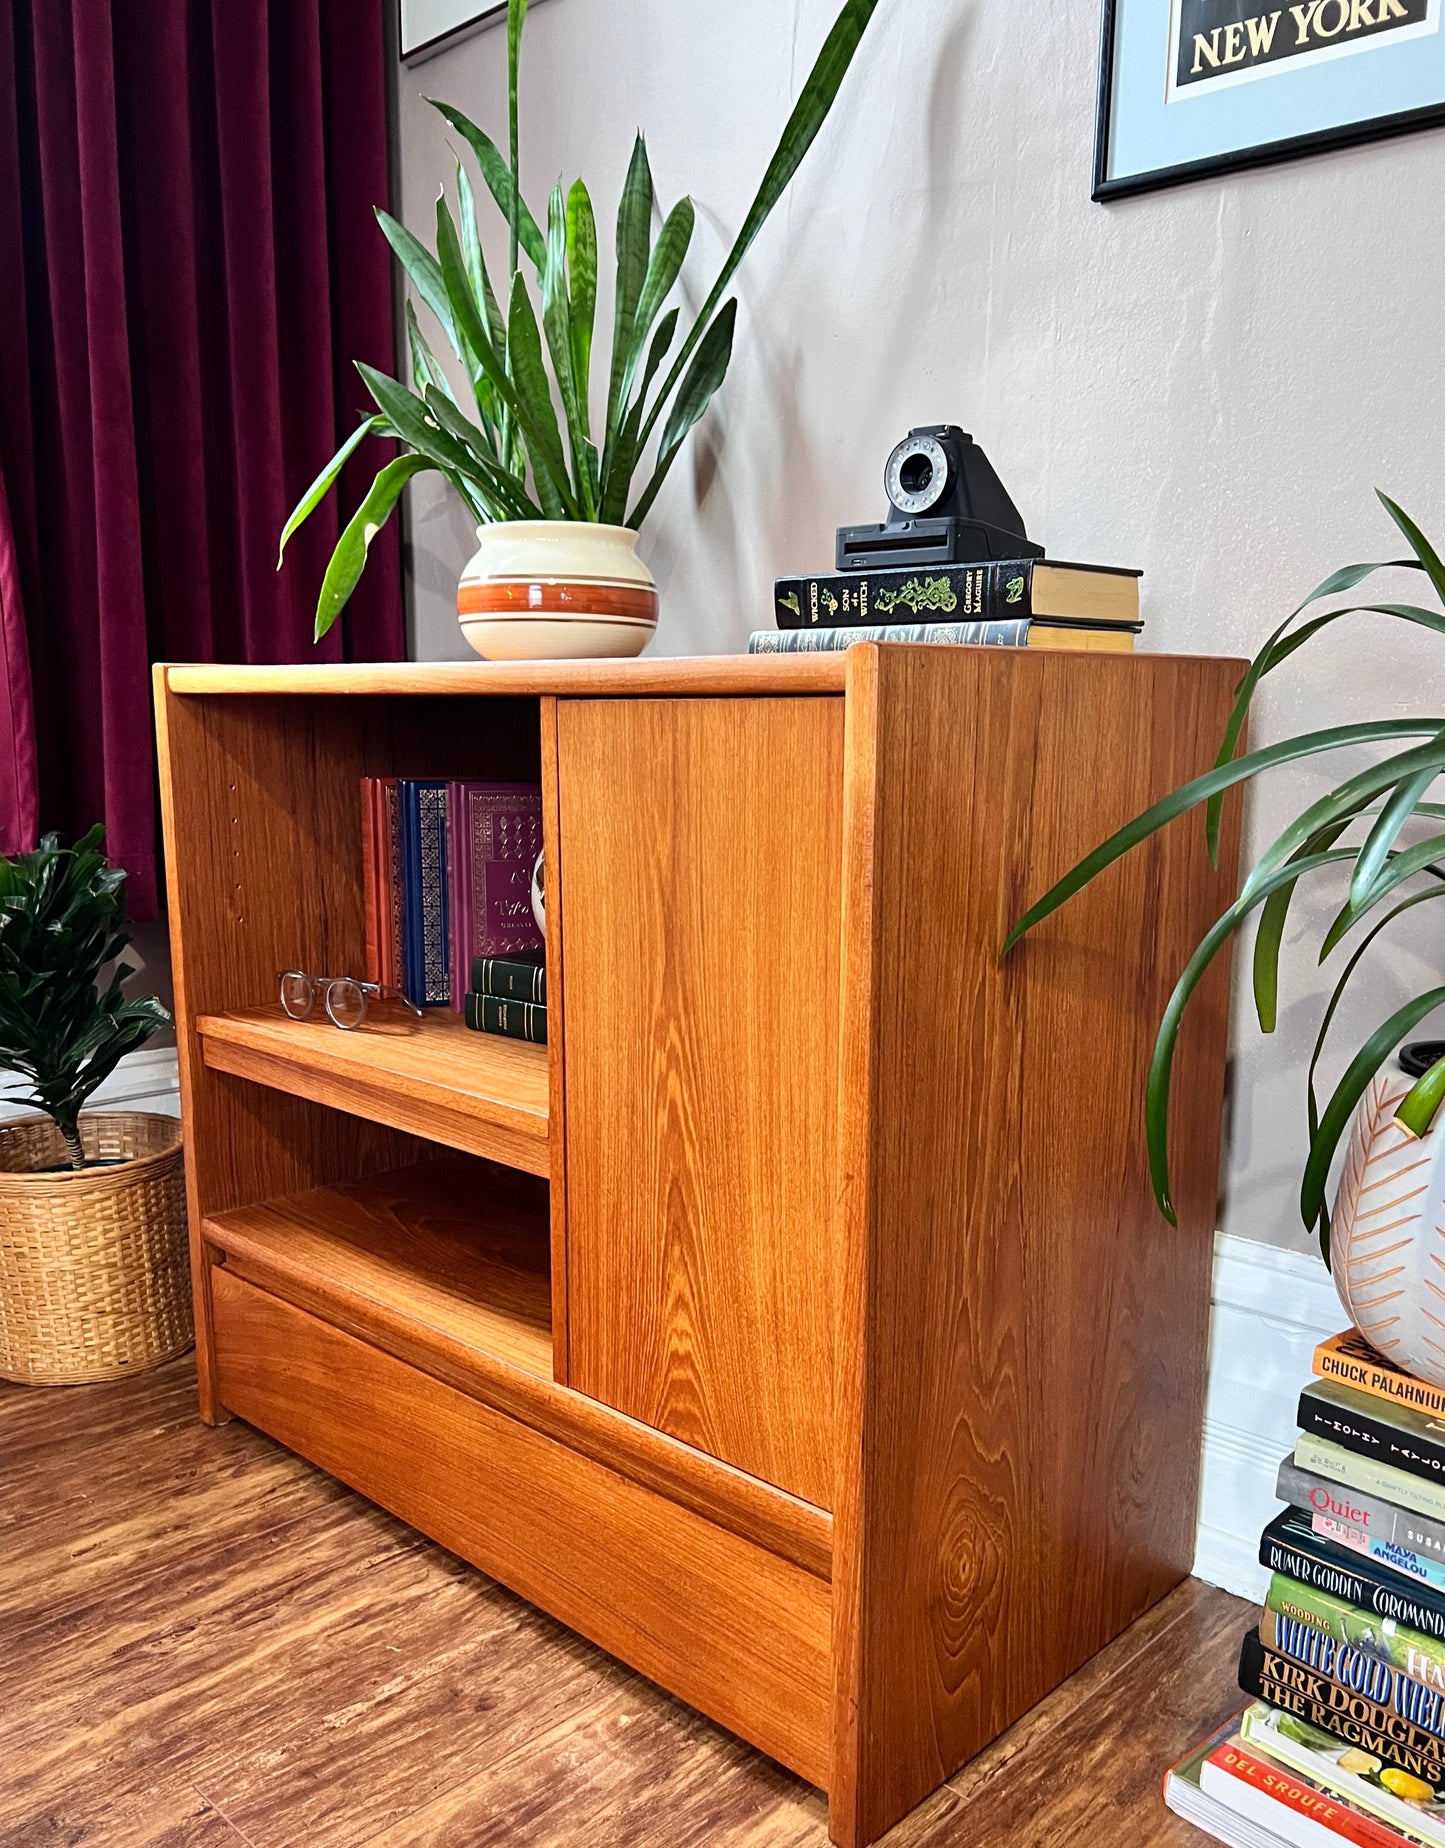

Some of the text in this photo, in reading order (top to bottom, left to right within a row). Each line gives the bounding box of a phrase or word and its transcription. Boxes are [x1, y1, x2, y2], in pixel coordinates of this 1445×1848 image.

[1190, 11, 1282, 74] NEW
[810, 581, 819, 623] WICKED
[842, 588, 850, 612] SON
[860, 581, 868, 617] WITCH
[963, 570, 973, 614] GREGORY
[973, 568, 984, 613] MAGUIRE
[1321, 1356, 1368, 1385] CHUCK
[1314, 1414, 1380, 1444] TIMOTHY
[1308, 1487, 1371, 1527] Quiet
[1385, 1542, 1417, 1564] MAYA
[1407, 1530, 1445, 1552] SUSA
[1373, 1547, 1428, 1578] ANGELOU
[1270, 1546, 1445, 1638] RUMER GODDEN COROMAND
[1281, 1601, 1331, 1631] WOODING
[1263, 1651, 1327, 1702] KIRK
[1275, 1612, 1445, 1741] WHITE GOLD WIEL
[1259, 1677, 1442, 1783] THE RAGMAN'S
[1224, 1753, 1339, 1820] DEL SROUFE
